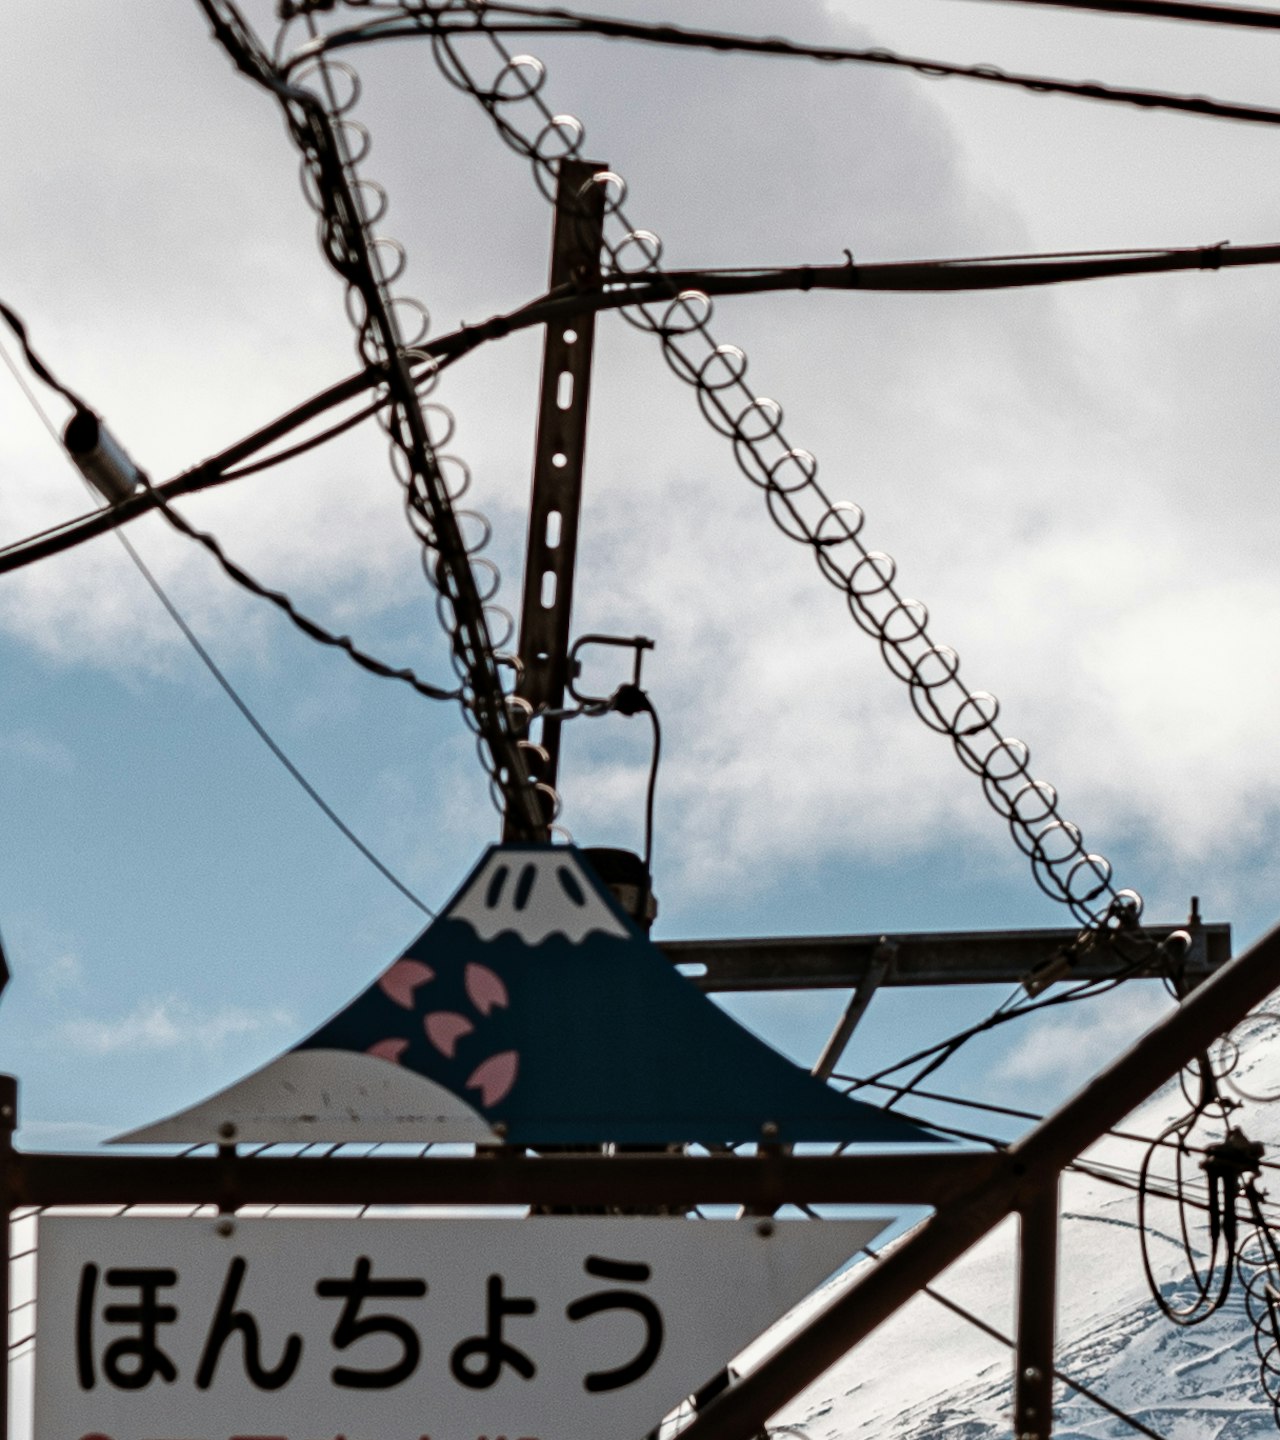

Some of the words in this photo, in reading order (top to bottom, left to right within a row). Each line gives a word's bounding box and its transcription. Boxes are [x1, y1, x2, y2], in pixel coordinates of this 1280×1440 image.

[76, 1256, 664, 1393] ほんちょう
